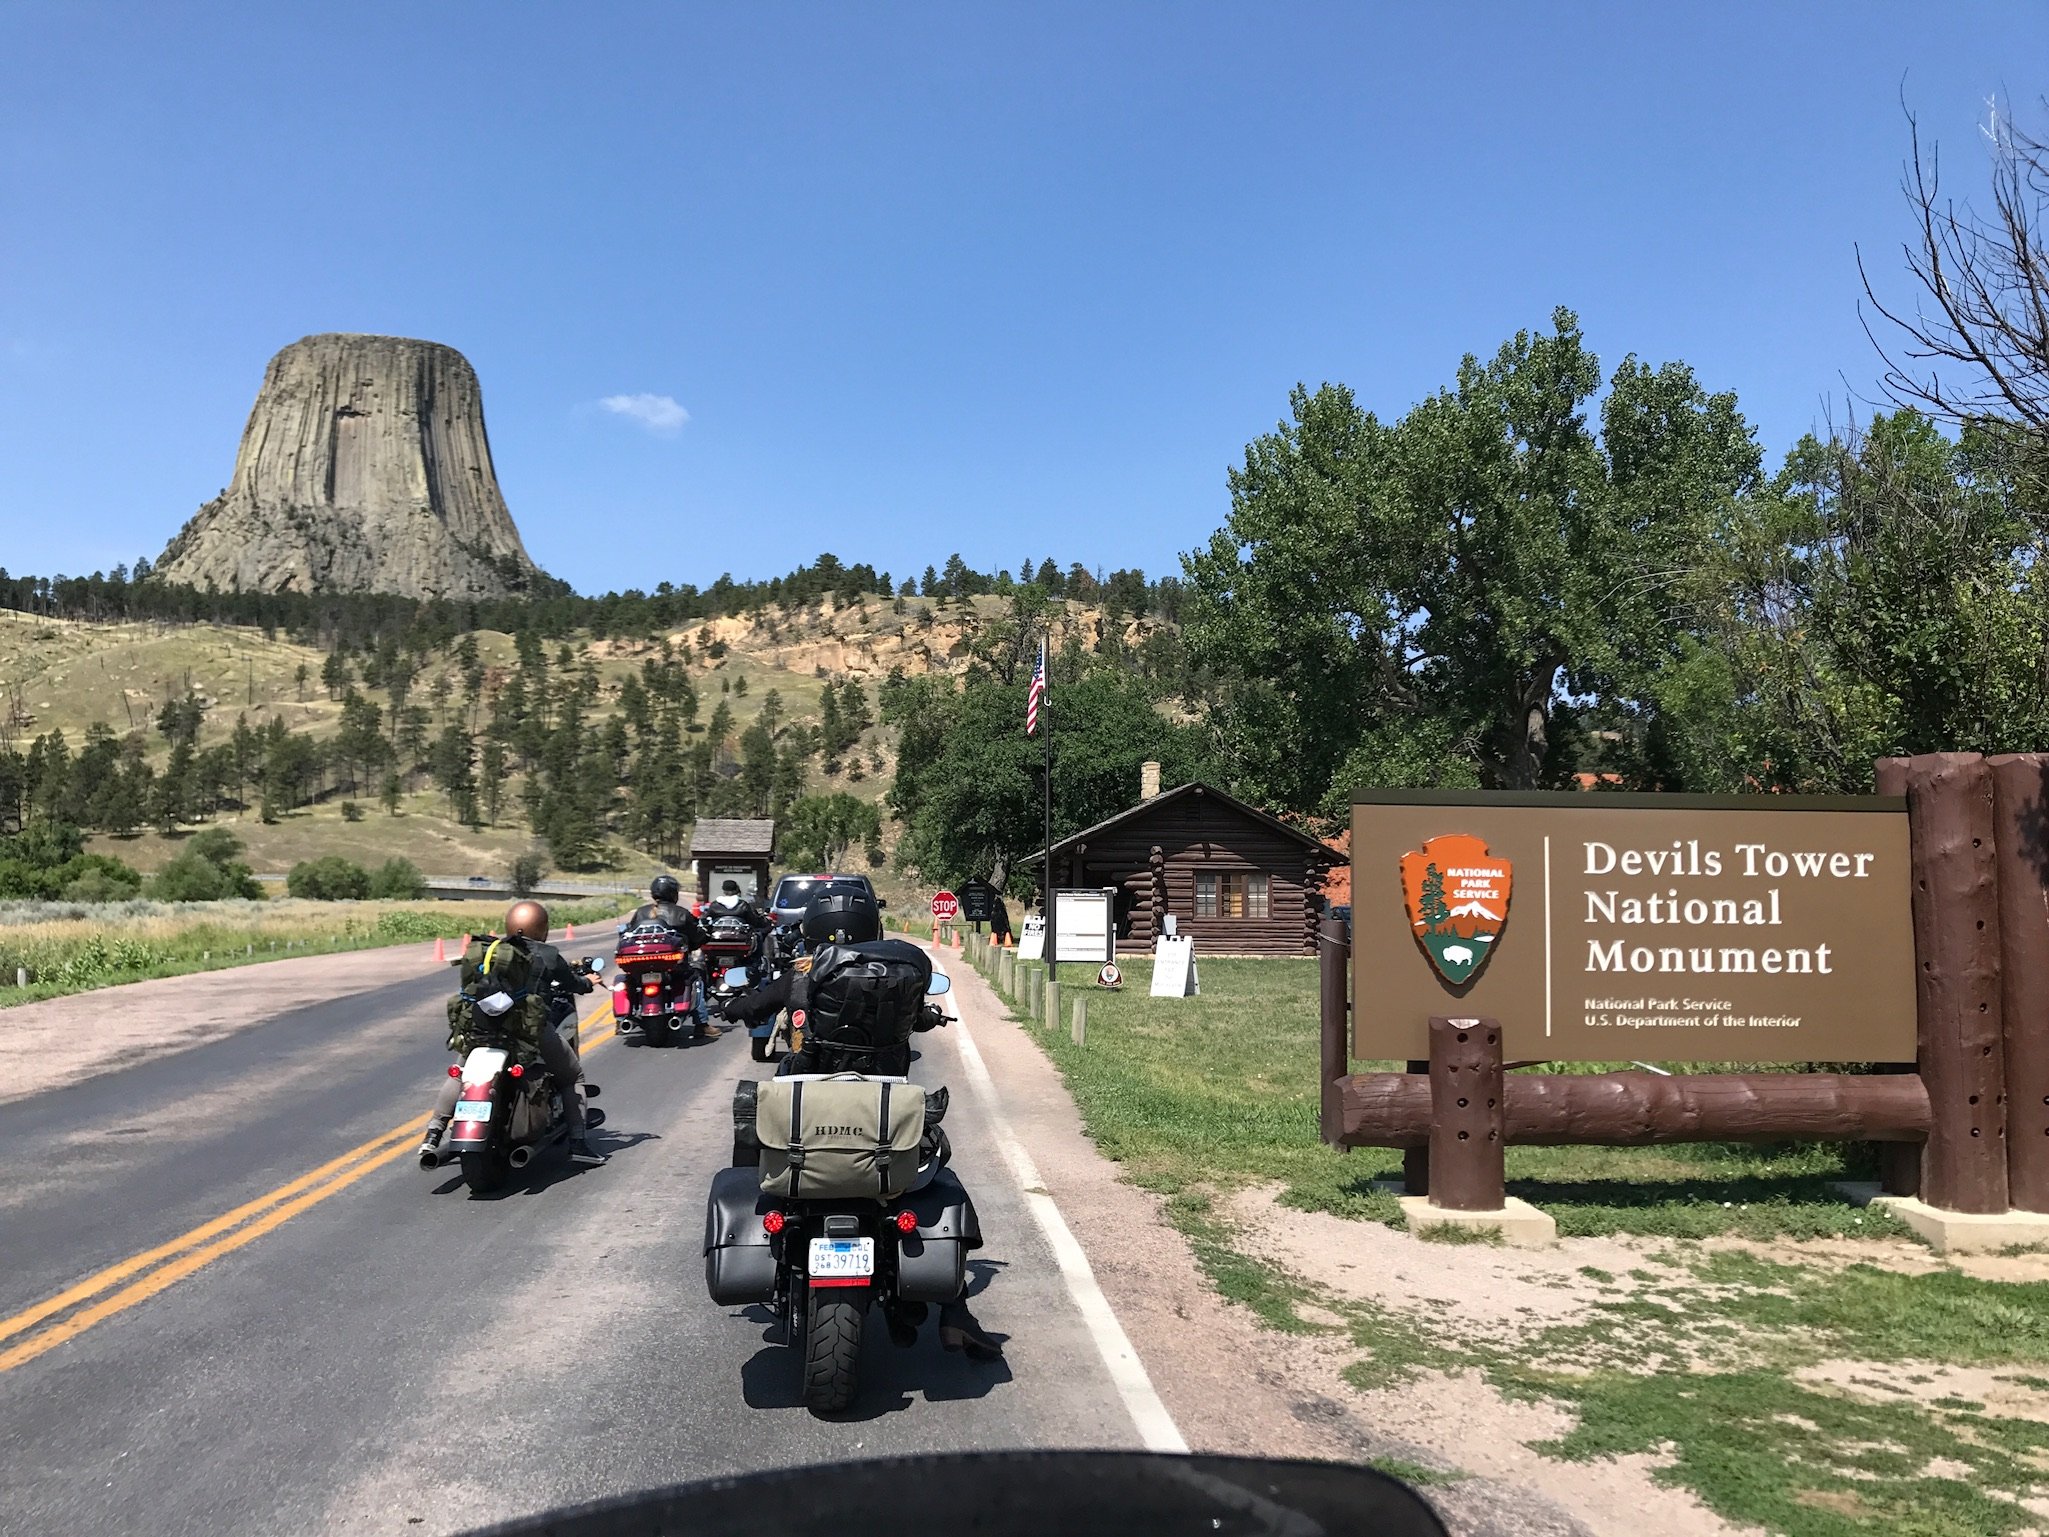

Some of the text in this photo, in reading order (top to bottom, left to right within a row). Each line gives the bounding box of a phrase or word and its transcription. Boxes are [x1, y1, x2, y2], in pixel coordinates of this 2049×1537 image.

[1583, 840, 1874, 877] Devils Tower
[1447, 868, 1505, 878] NATIONAL
[1461, 879, 1491, 888] PARK
[1453, 889, 1500, 899] SERVICE
[933, 900, 957, 912] STOP
[1584, 889, 1782, 924] National
[1024, 929, 1044, 937] FIRES
[1585, 940, 1832, 973] Monument
[1584, 997, 1732, 1011] National Park Service
[1584, 1014, 1802, 1030] U.S. Department of the Interior
[833, 1253, 869, 1269] 39719
